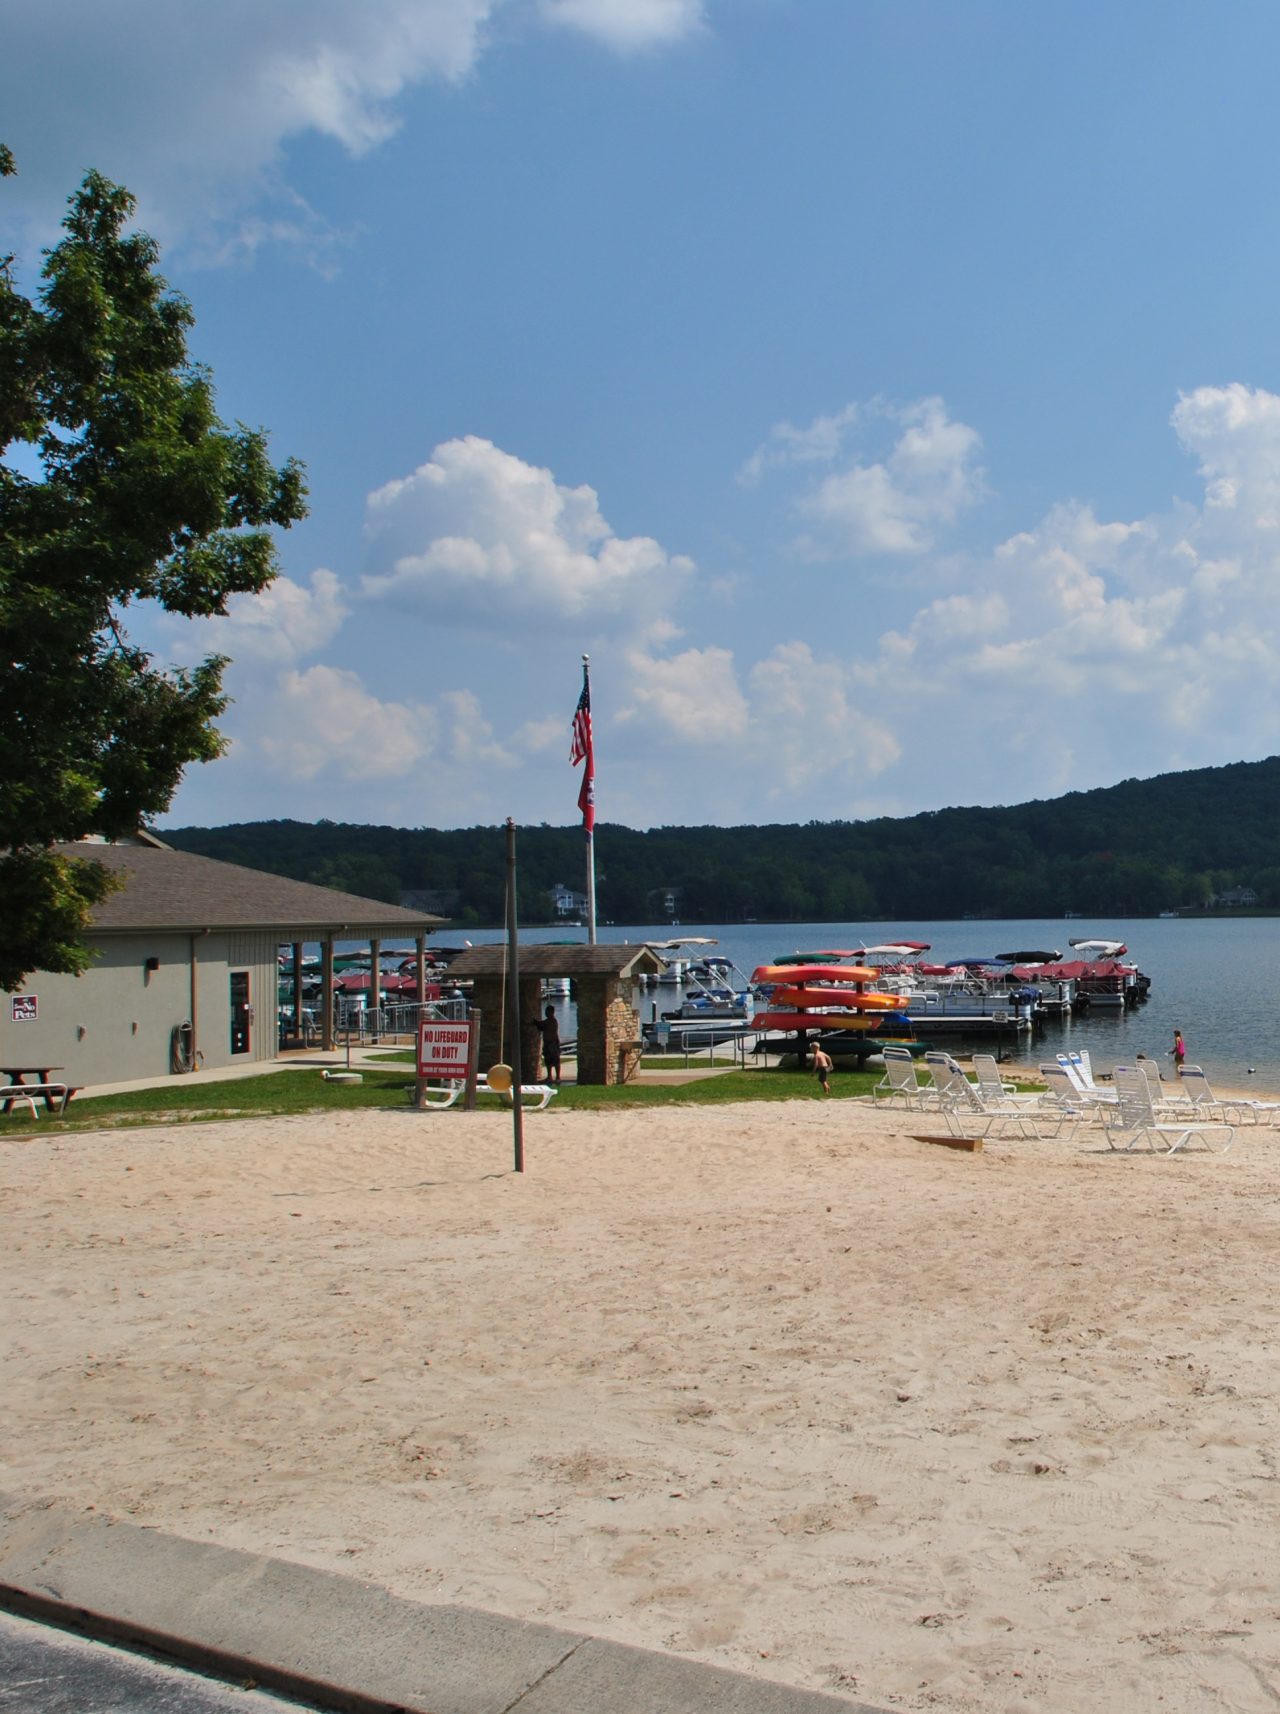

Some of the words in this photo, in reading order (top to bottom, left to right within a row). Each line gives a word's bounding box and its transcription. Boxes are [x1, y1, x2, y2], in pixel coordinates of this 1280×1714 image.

[23, 1002, 35, 1011] No
[15, 1010, 35, 1019] Pets
[424, 1031, 433, 1043] NO
[434, 1031, 467, 1043] LIFEGUARD
[432, 1047, 441, 1059] ON
[442, 1047, 458, 1059] DUTY
